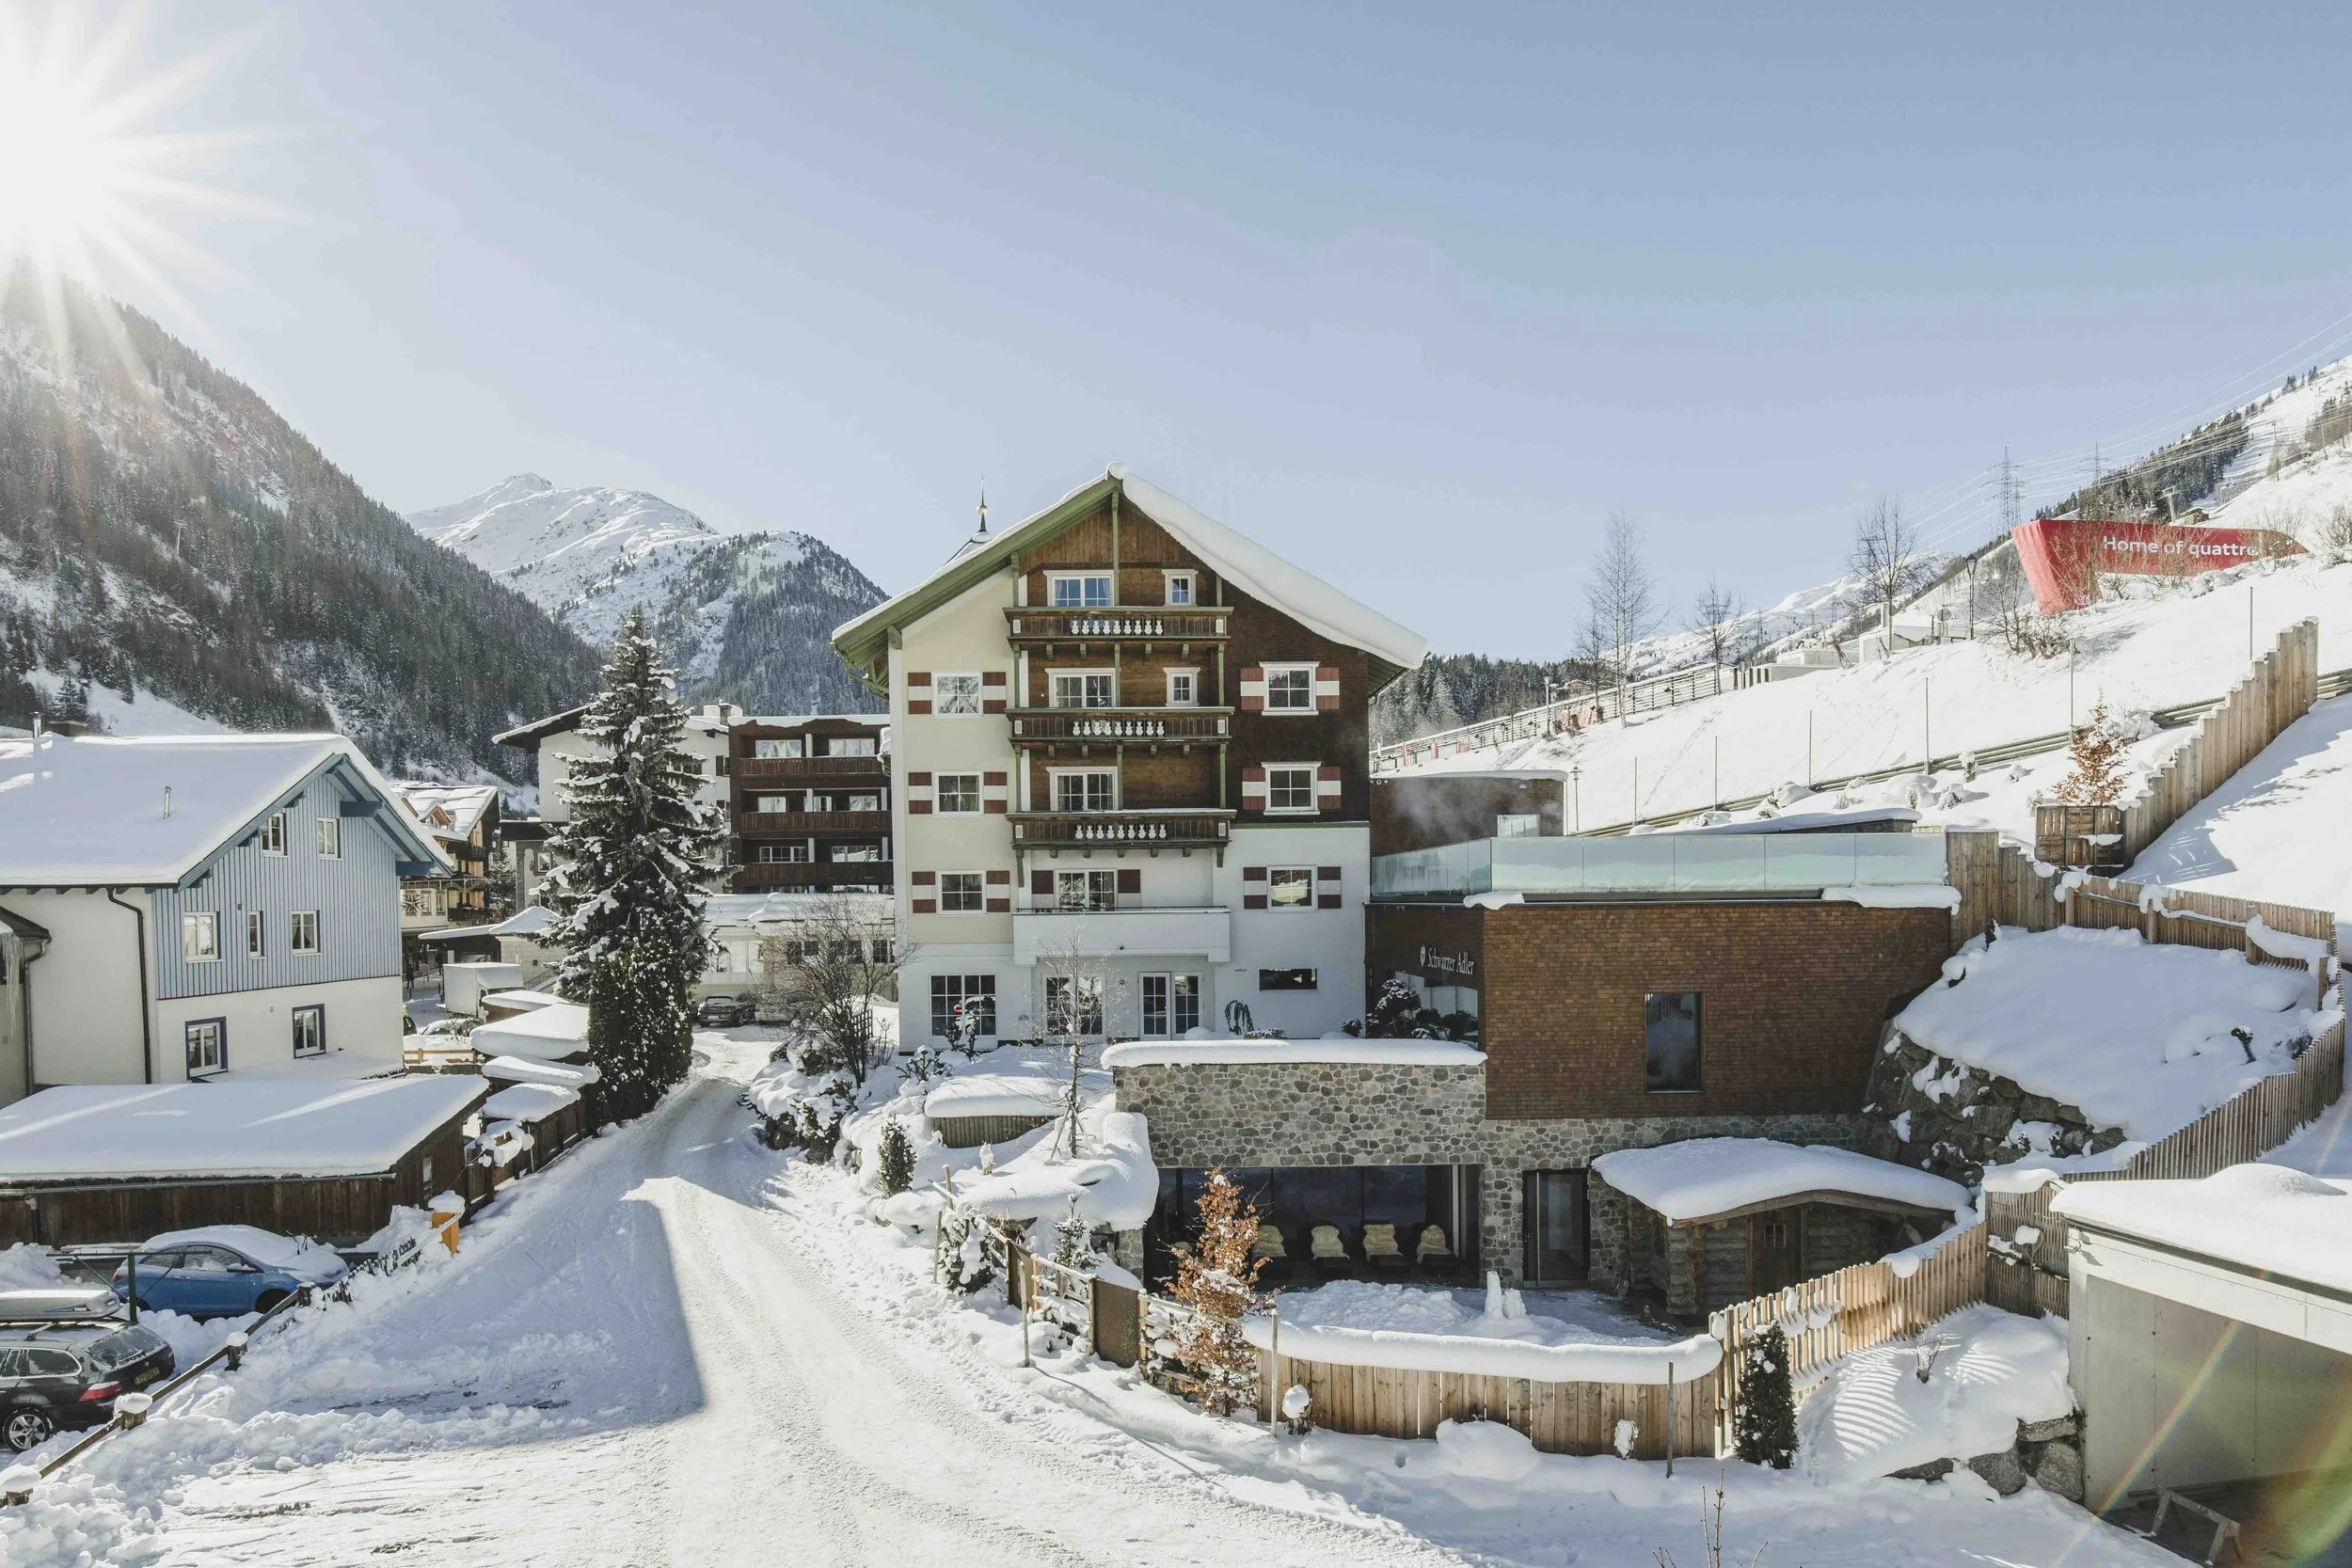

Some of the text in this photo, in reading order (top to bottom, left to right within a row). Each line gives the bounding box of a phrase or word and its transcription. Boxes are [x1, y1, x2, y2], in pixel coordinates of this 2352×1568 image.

[2103, 535, 2159, 553] Home
[2163, 540, 2184, 555] of
[1427, 947, 1474, 975] Schwarzer Adler
